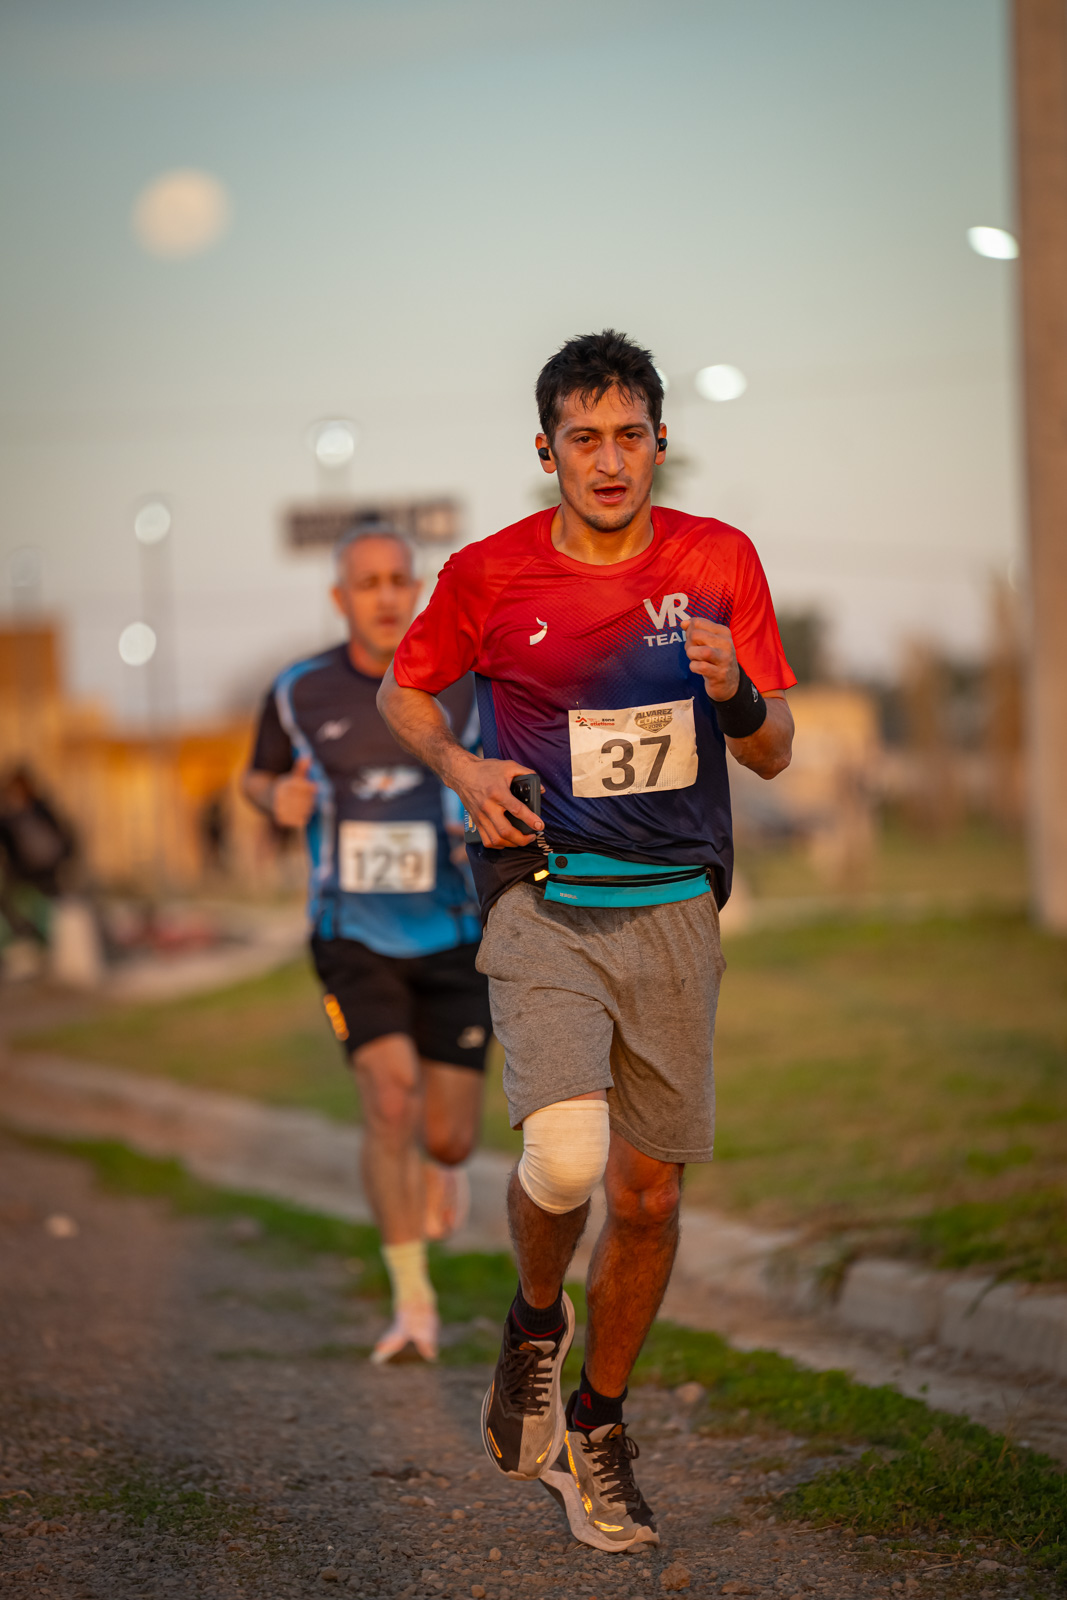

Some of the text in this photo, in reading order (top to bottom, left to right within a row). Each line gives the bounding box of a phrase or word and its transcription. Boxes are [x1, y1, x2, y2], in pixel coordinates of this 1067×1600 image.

[643, 592, 692, 630] VR
[643, 630, 688, 647] TEA
[635, 708, 673, 720] ALVAREZ
[637, 715, 672, 725] CORRE
[601, 734, 671, 791] 37
